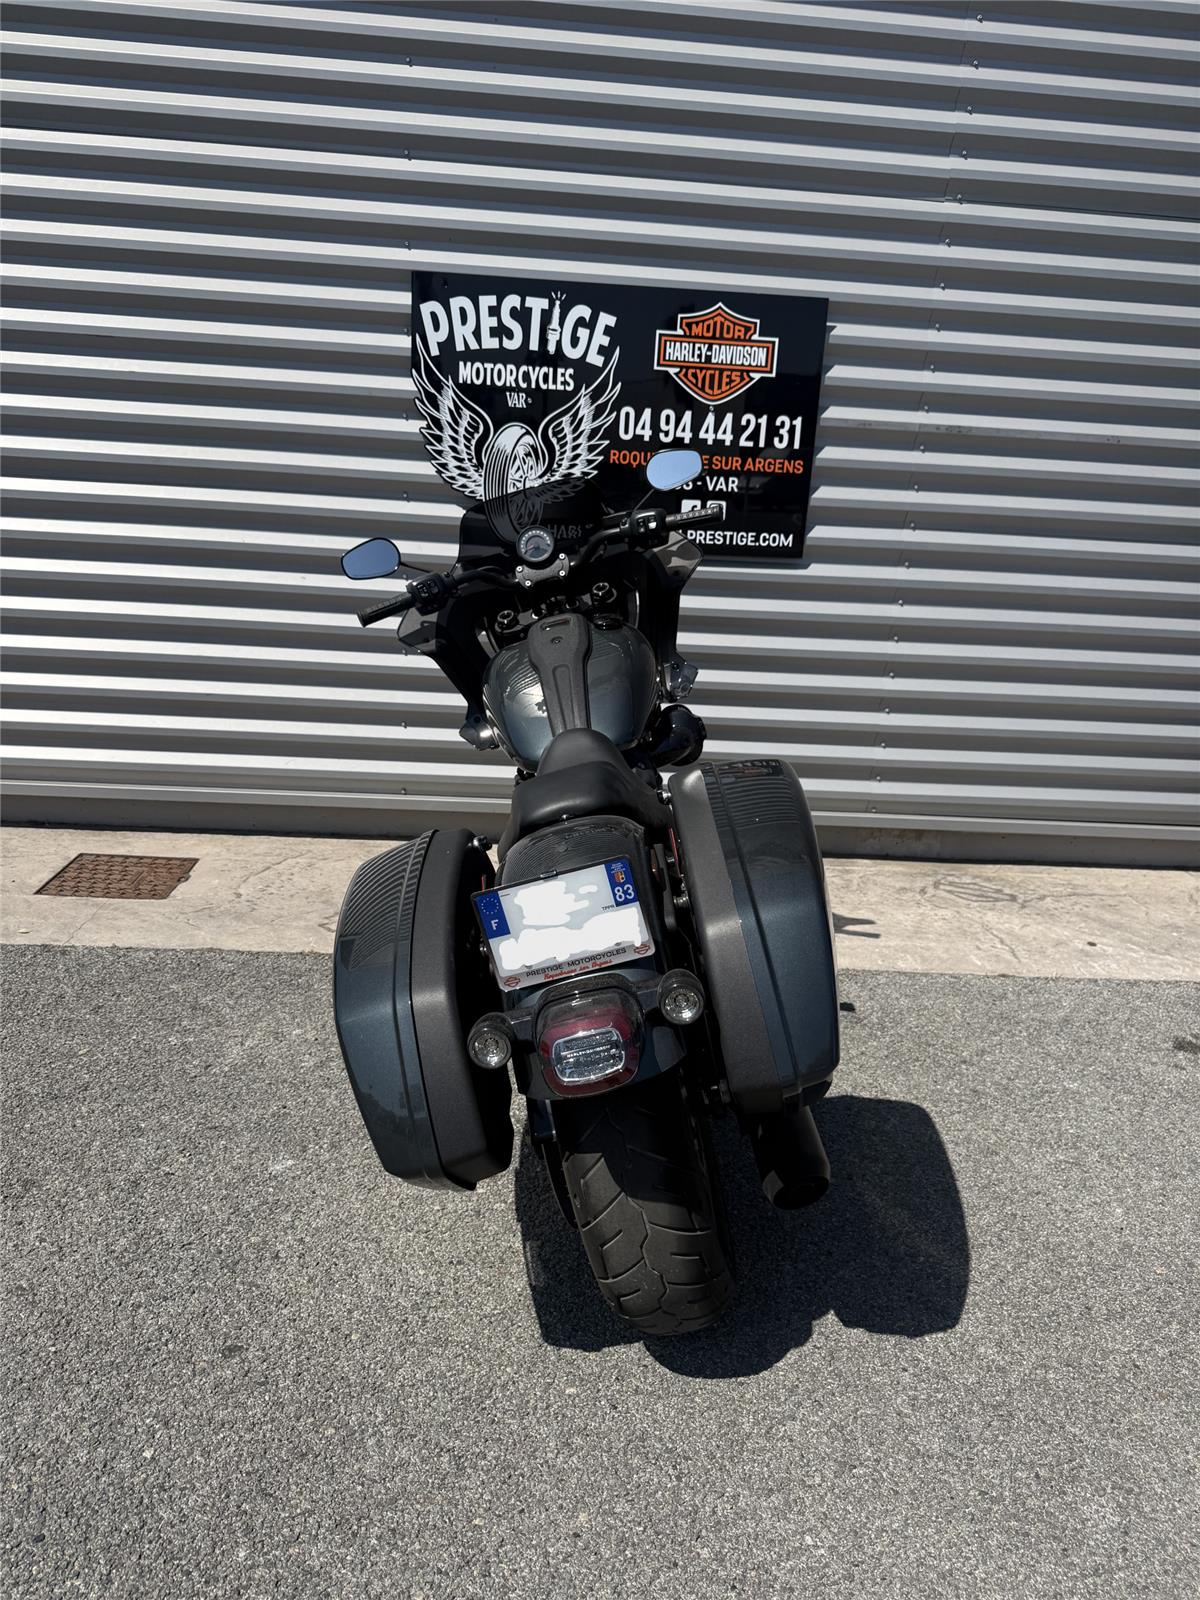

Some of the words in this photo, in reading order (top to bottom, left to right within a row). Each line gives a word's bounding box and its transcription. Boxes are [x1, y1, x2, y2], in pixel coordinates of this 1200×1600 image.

[419, 292, 618, 367] PRESTIGE
[691, 316, 745, 339] MOTOR
[665, 341, 767, 367] HARLEY-DAVIDSON
[458, 361, 575, 391] MOTORCYCLES
[687, 368, 741, 395] CYCLES
[506, 391, 527, 408] VAR
[618, 406, 652, 442] 04
[659, 409, 693, 444] 94
[698, 412, 734, 446] 44
[739, 413, 768, 448] 21
[773, 415, 803, 449] 31
[711, 455, 742, 472] SUR
[743, 457, 804, 474] ARGENS
[705, 475, 739, 492] VAR
[614, 884, 635, 901] 83
[491, 919, 499, 931] F
[526, 962, 564, 977] PRESTIGE
[567, 947, 627, 968] MOTORCYCLES
